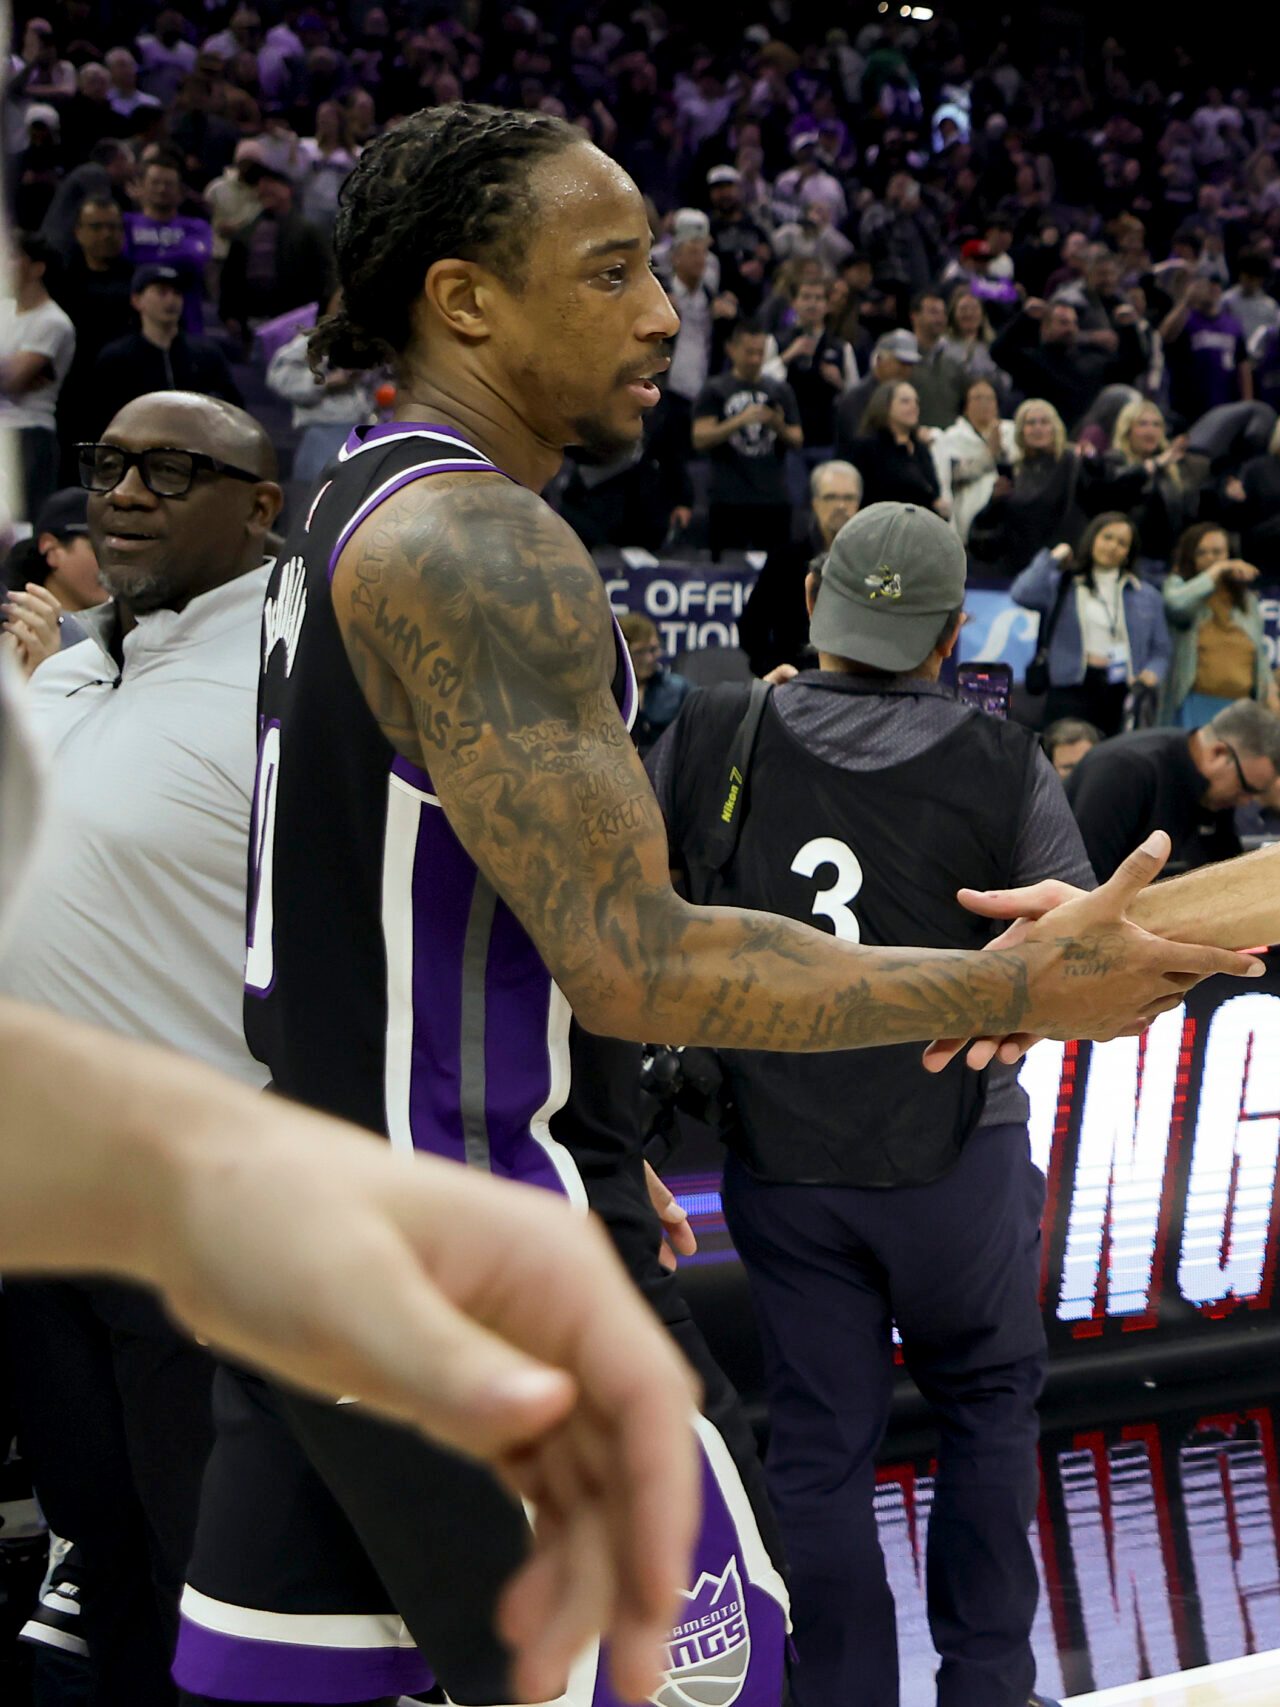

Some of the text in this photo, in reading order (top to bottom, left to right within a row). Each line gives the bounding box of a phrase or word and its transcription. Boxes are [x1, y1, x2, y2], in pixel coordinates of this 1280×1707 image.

[720, 784, 739, 823] Nikon
[790, 836, 863, 944] 3
[668, 1614, 747, 1668] NGS
[671, 1601, 739, 1638] AMENTO
